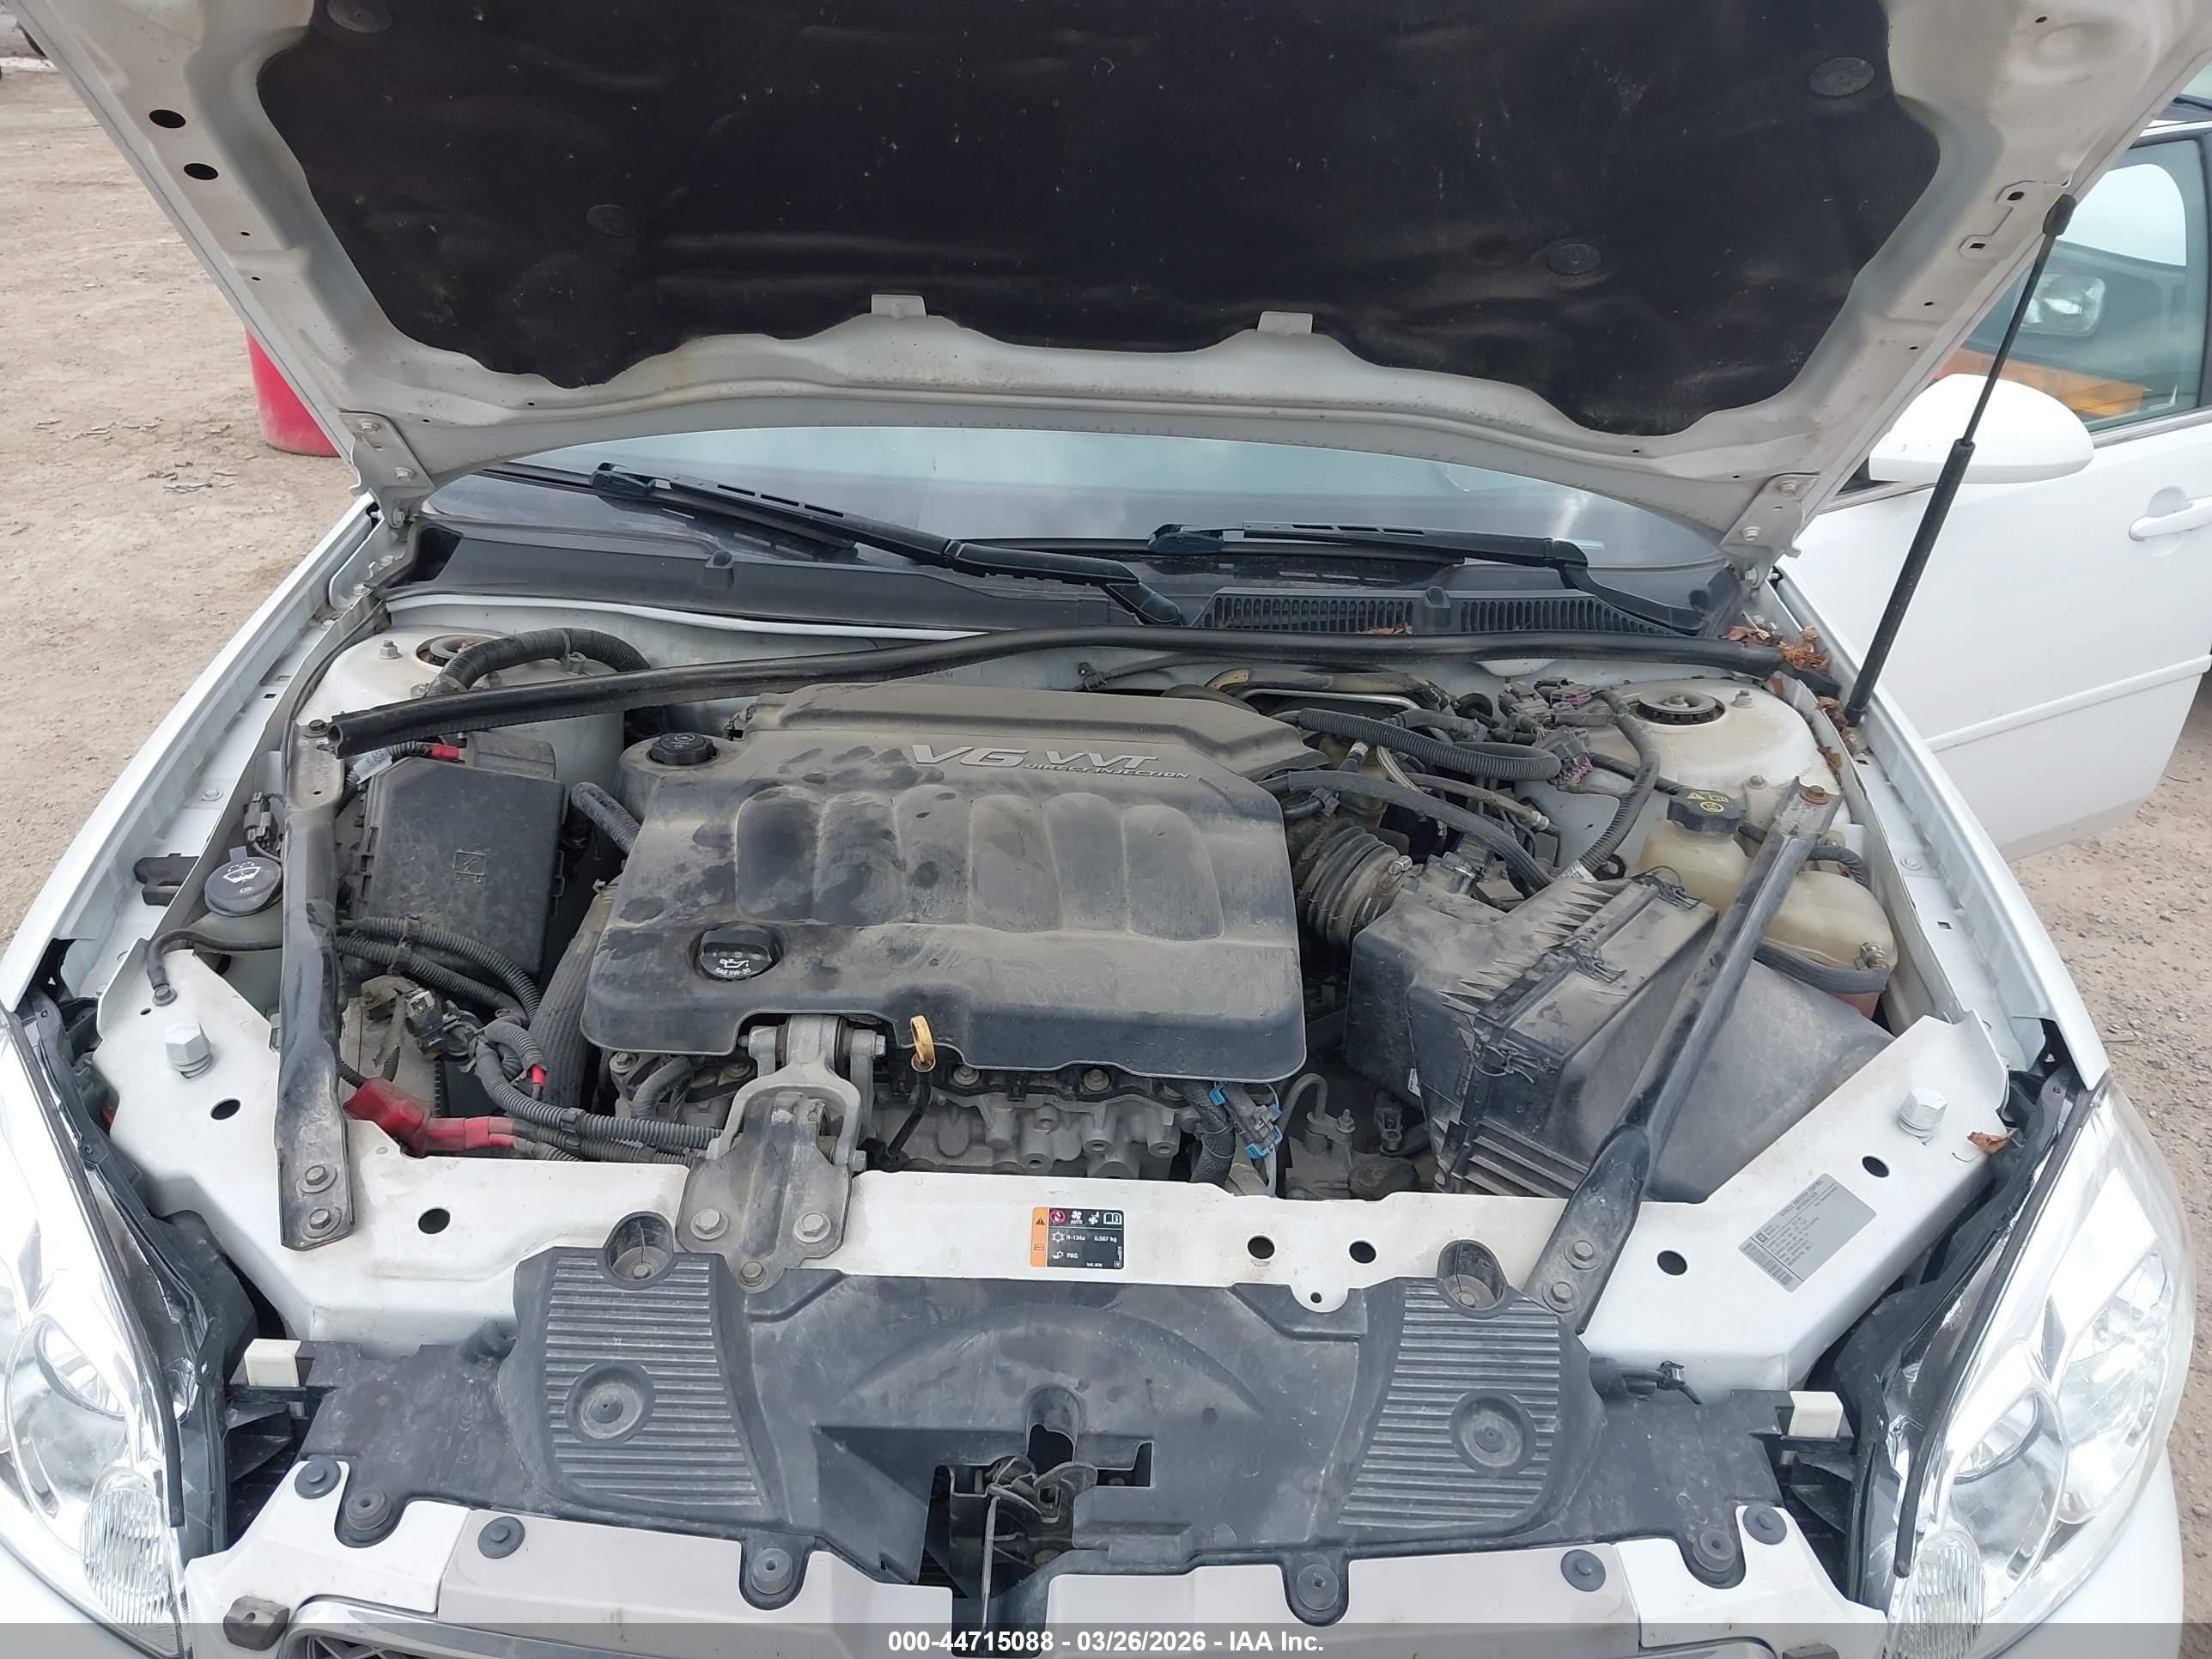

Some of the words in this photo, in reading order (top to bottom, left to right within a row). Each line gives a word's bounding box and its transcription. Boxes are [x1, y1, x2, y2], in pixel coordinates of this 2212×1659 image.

[912, 744, 1029, 768] V6
[1046, 750, 1158, 769] VVT
[1024, 763, 1093, 773] DIRECT
[1094, 767, 1190, 779] INJECTION
[714, 967, 729, 976] SAE
[728, 967, 751, 976] 5W-30
